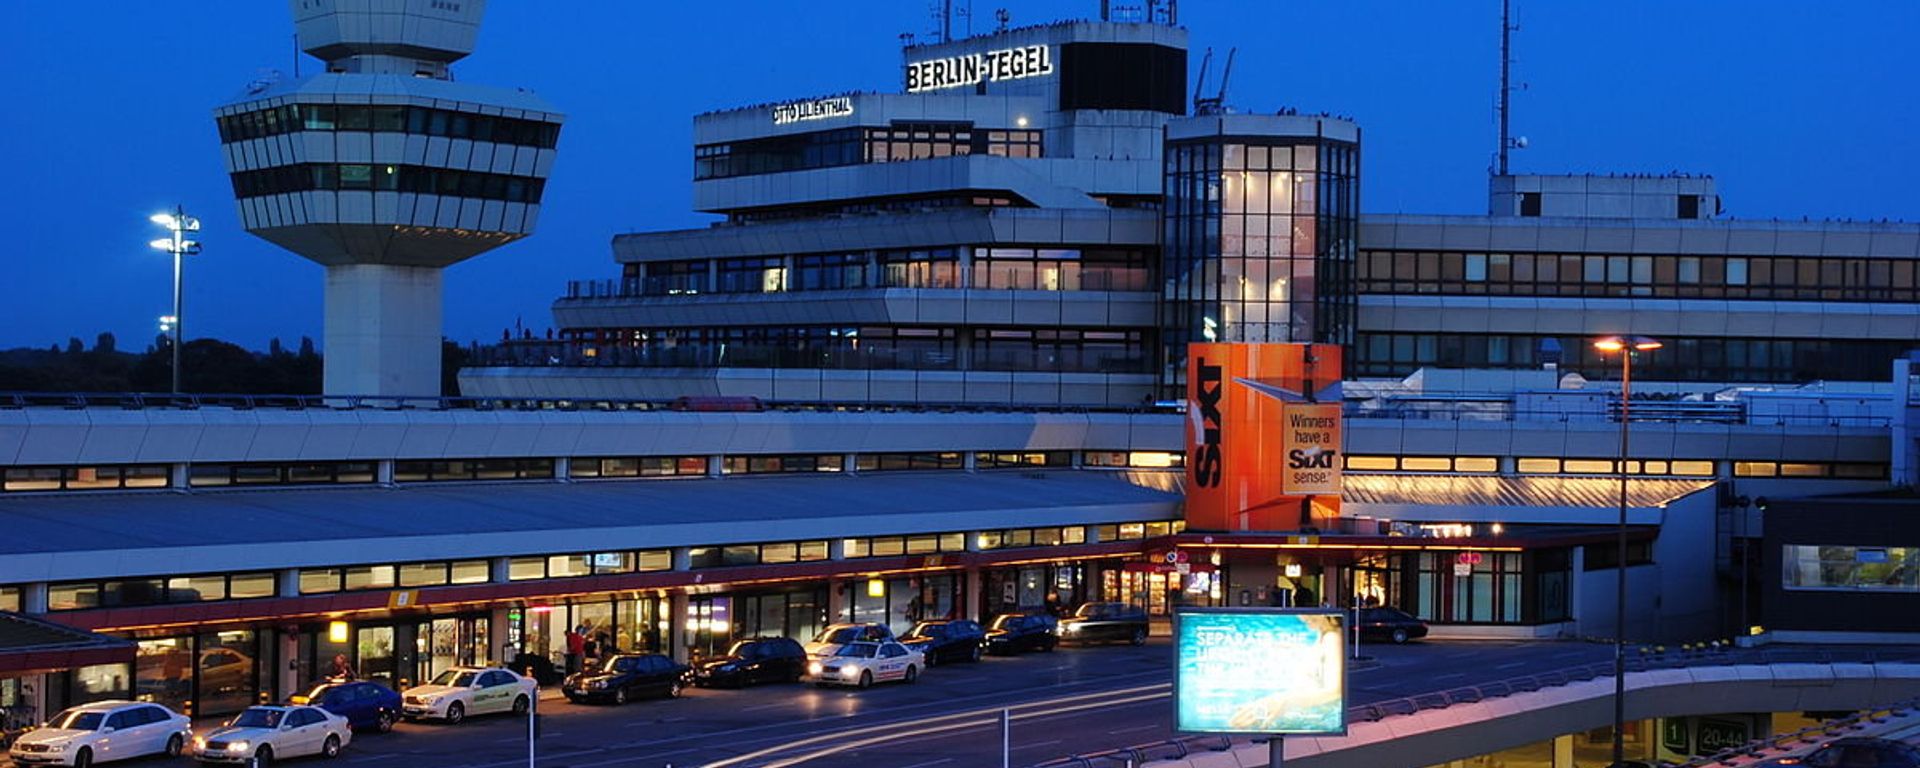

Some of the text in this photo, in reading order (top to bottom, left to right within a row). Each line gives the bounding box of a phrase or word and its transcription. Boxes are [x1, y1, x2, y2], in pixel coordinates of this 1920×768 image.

[906, 45, 1053, 93] BERLIN-TEGEL
[772, 104, 799, 124] OTTO
[1195, 356, 1222, 488] SIXT
[1290, 415, 1335, 428] Winners
[1295, 431, 1331, 444] have a
[1670, 723, 1677, 740] 1
[1704, 725, 1745, 745] 20-44
